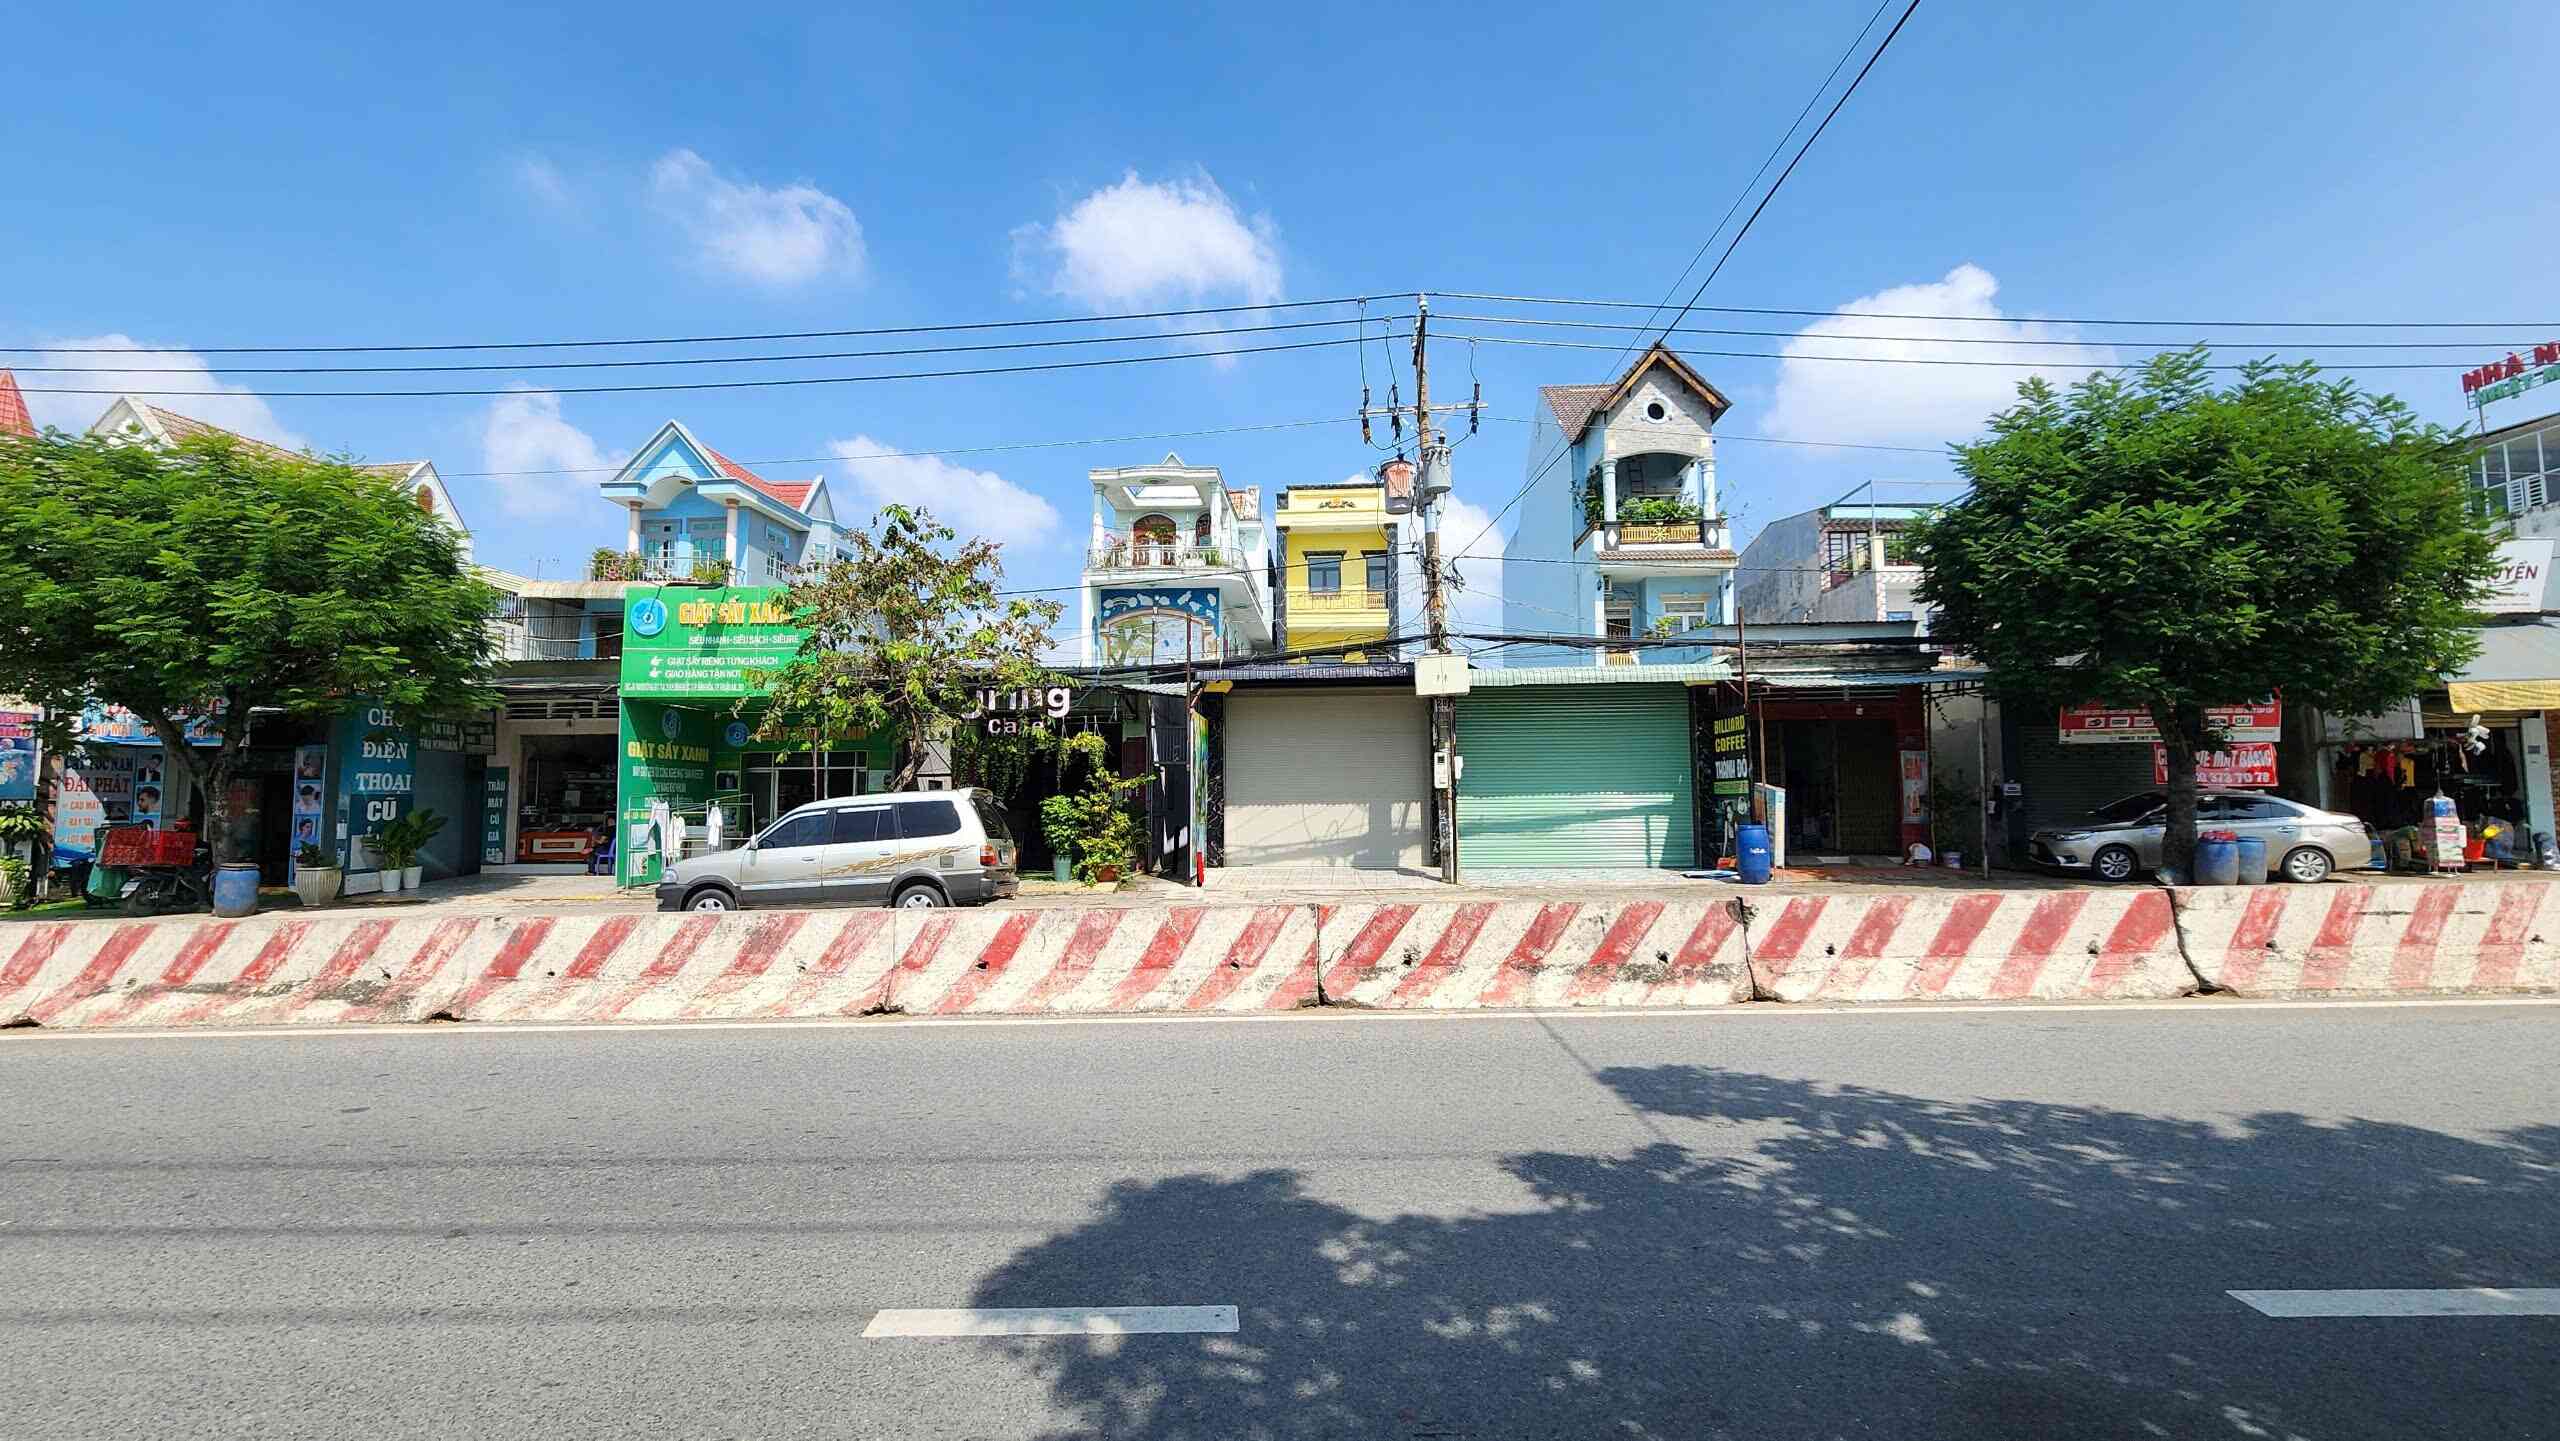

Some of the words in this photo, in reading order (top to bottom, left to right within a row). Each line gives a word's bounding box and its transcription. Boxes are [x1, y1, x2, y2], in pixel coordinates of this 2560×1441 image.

[1715, 734, 1747, 752] COFFEE
[95, 773, 131, 793] PHÁT
[355, 772, 412, 795] THOẠI
[366, 797, 397, 822] CŨ
